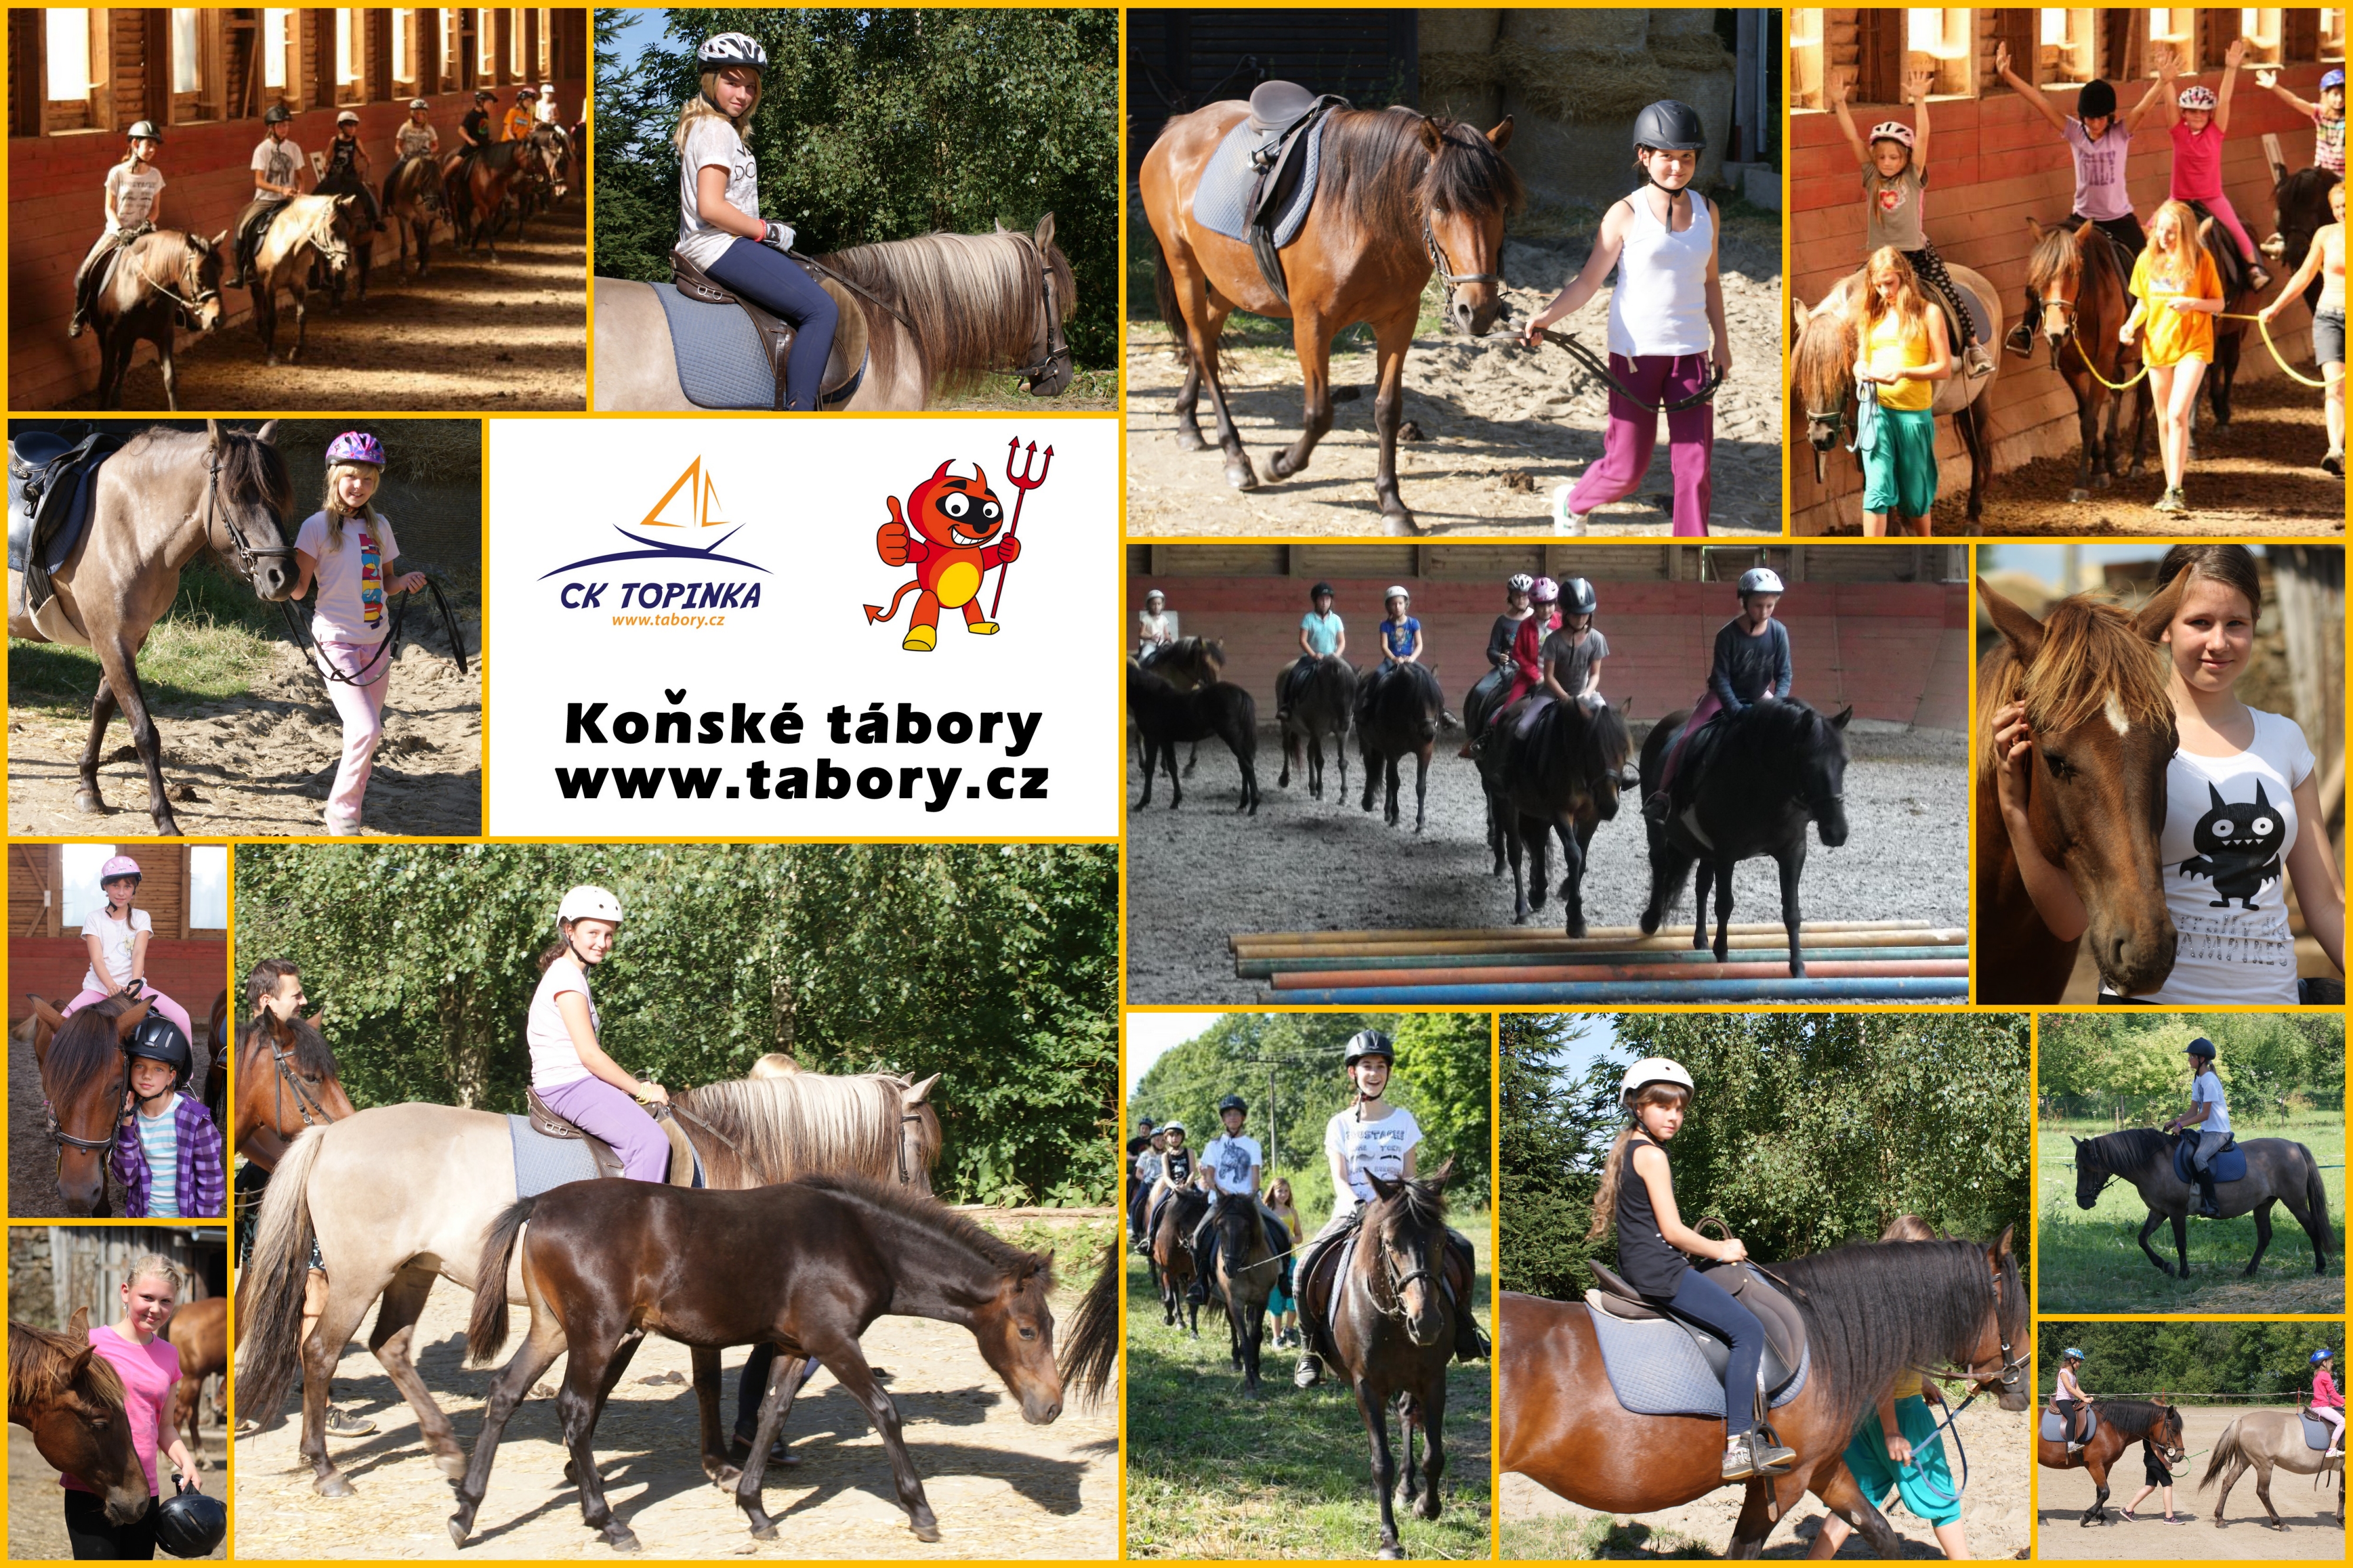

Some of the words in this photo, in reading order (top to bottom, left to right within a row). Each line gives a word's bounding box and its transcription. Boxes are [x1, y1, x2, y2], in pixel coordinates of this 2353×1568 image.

[361, 553, 382, 581] DO
[361, 579, 384, 630] JUST
[2177, 932, 2288, 966] AMPIRES
